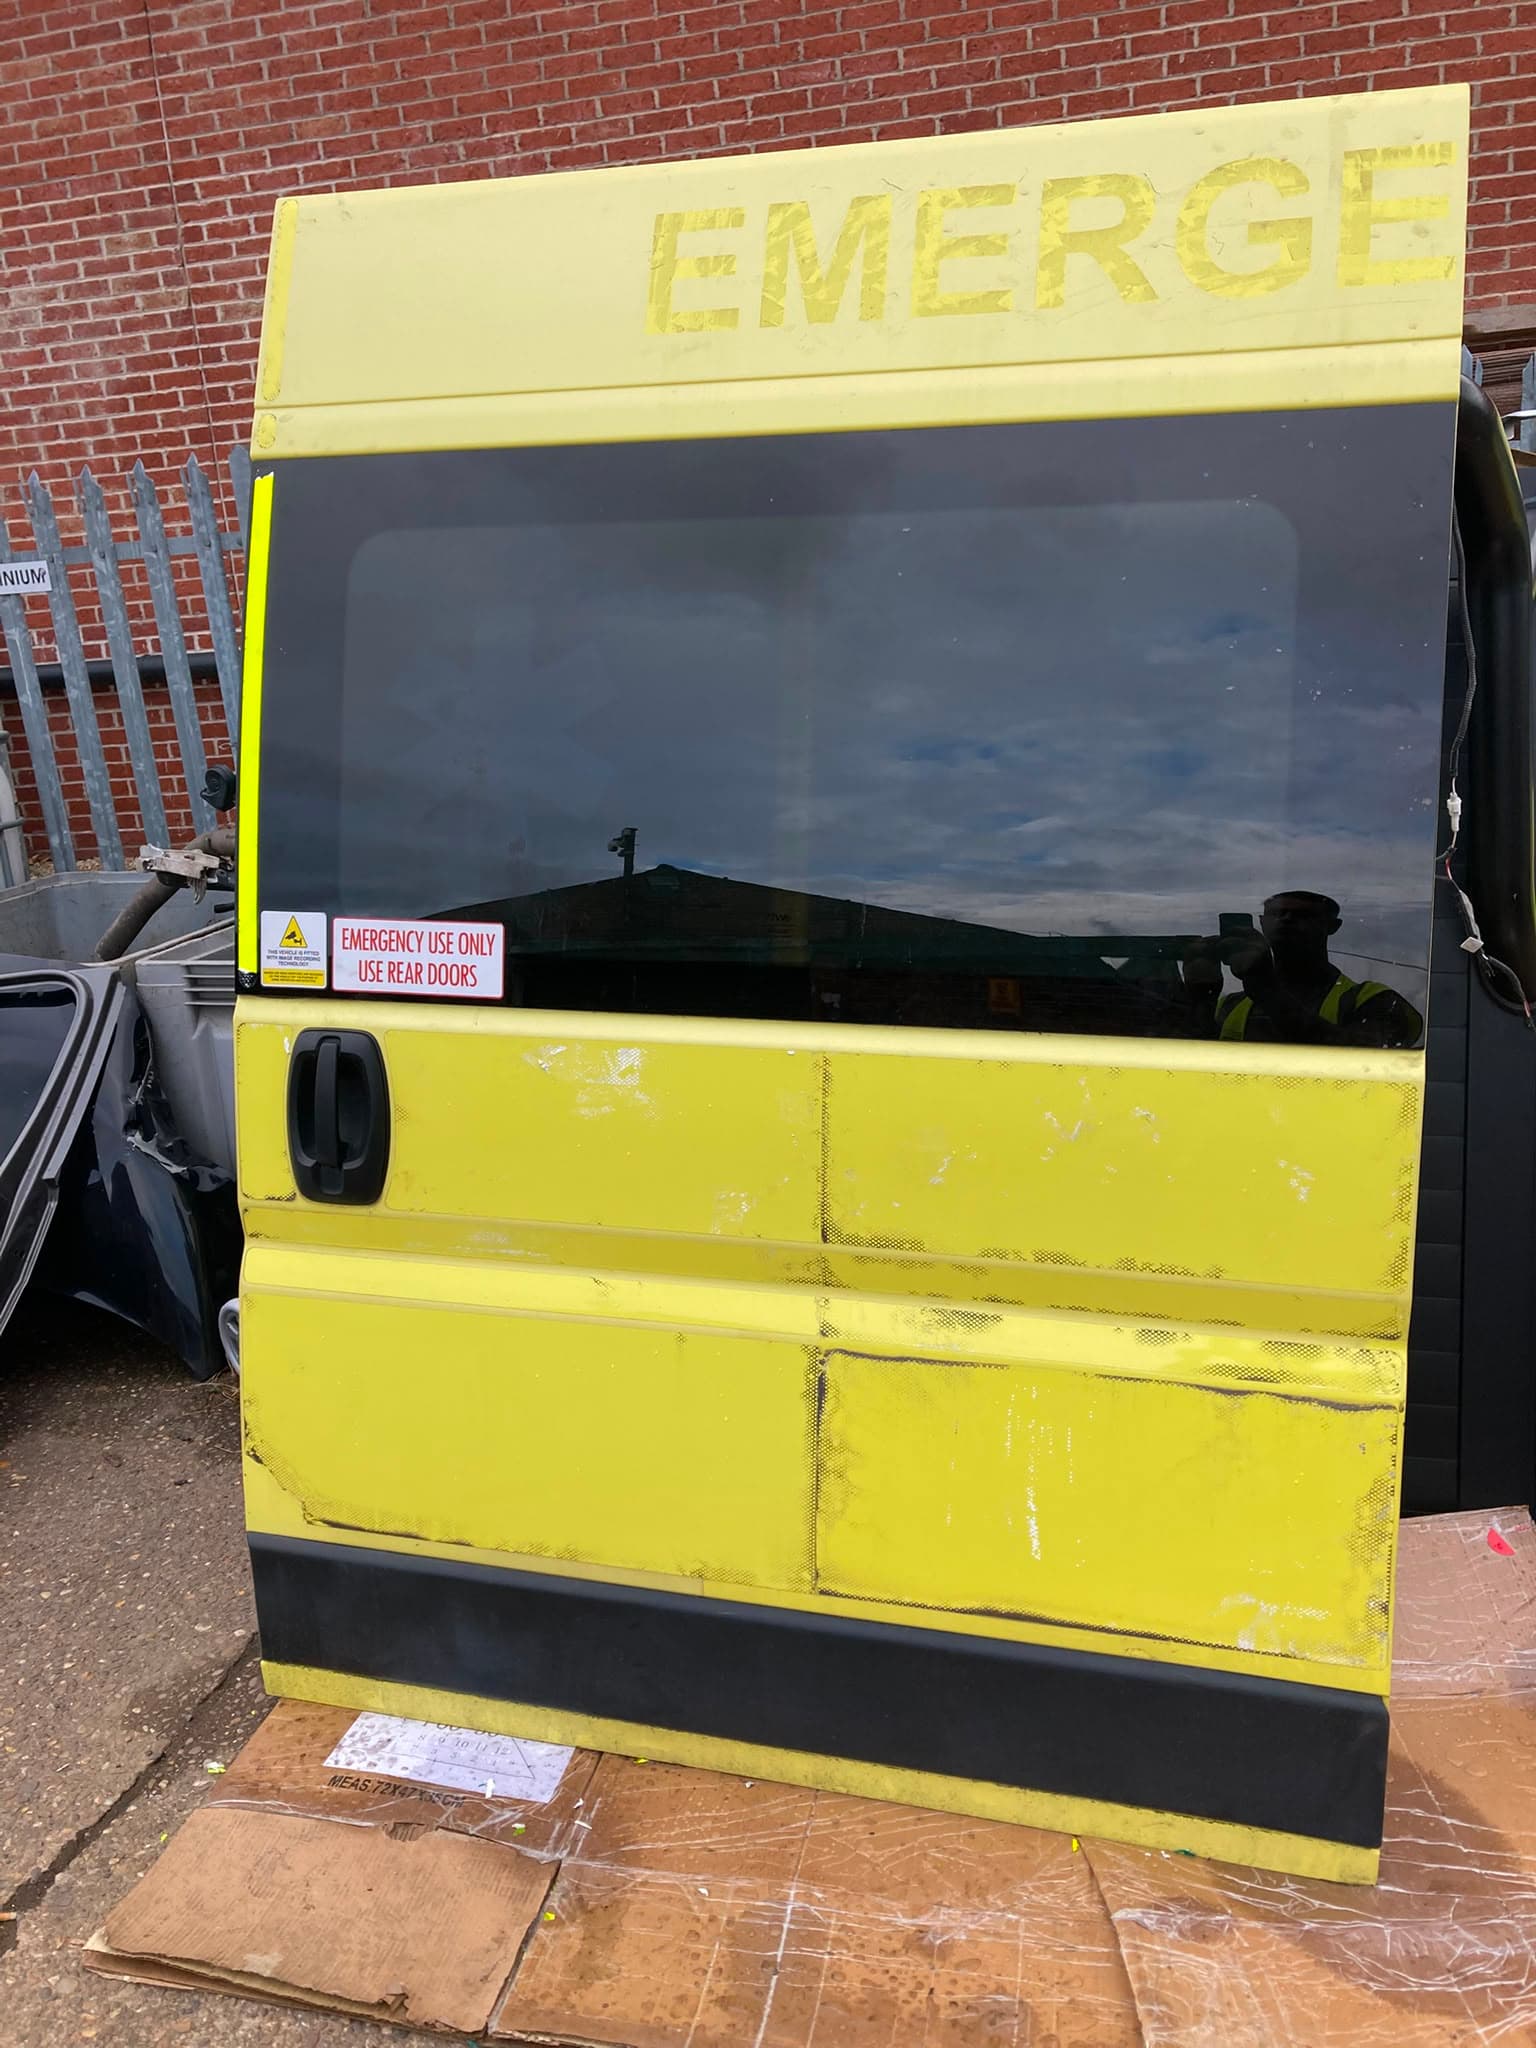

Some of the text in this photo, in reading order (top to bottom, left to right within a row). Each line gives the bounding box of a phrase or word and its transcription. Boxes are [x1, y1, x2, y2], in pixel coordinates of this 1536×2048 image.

[643, 140, 1457, 335] EMERGE
[341, 927, 496, 957] EMERGENCY USE ONLY
[358, 960, 477, 987] USE REAR DOORS
